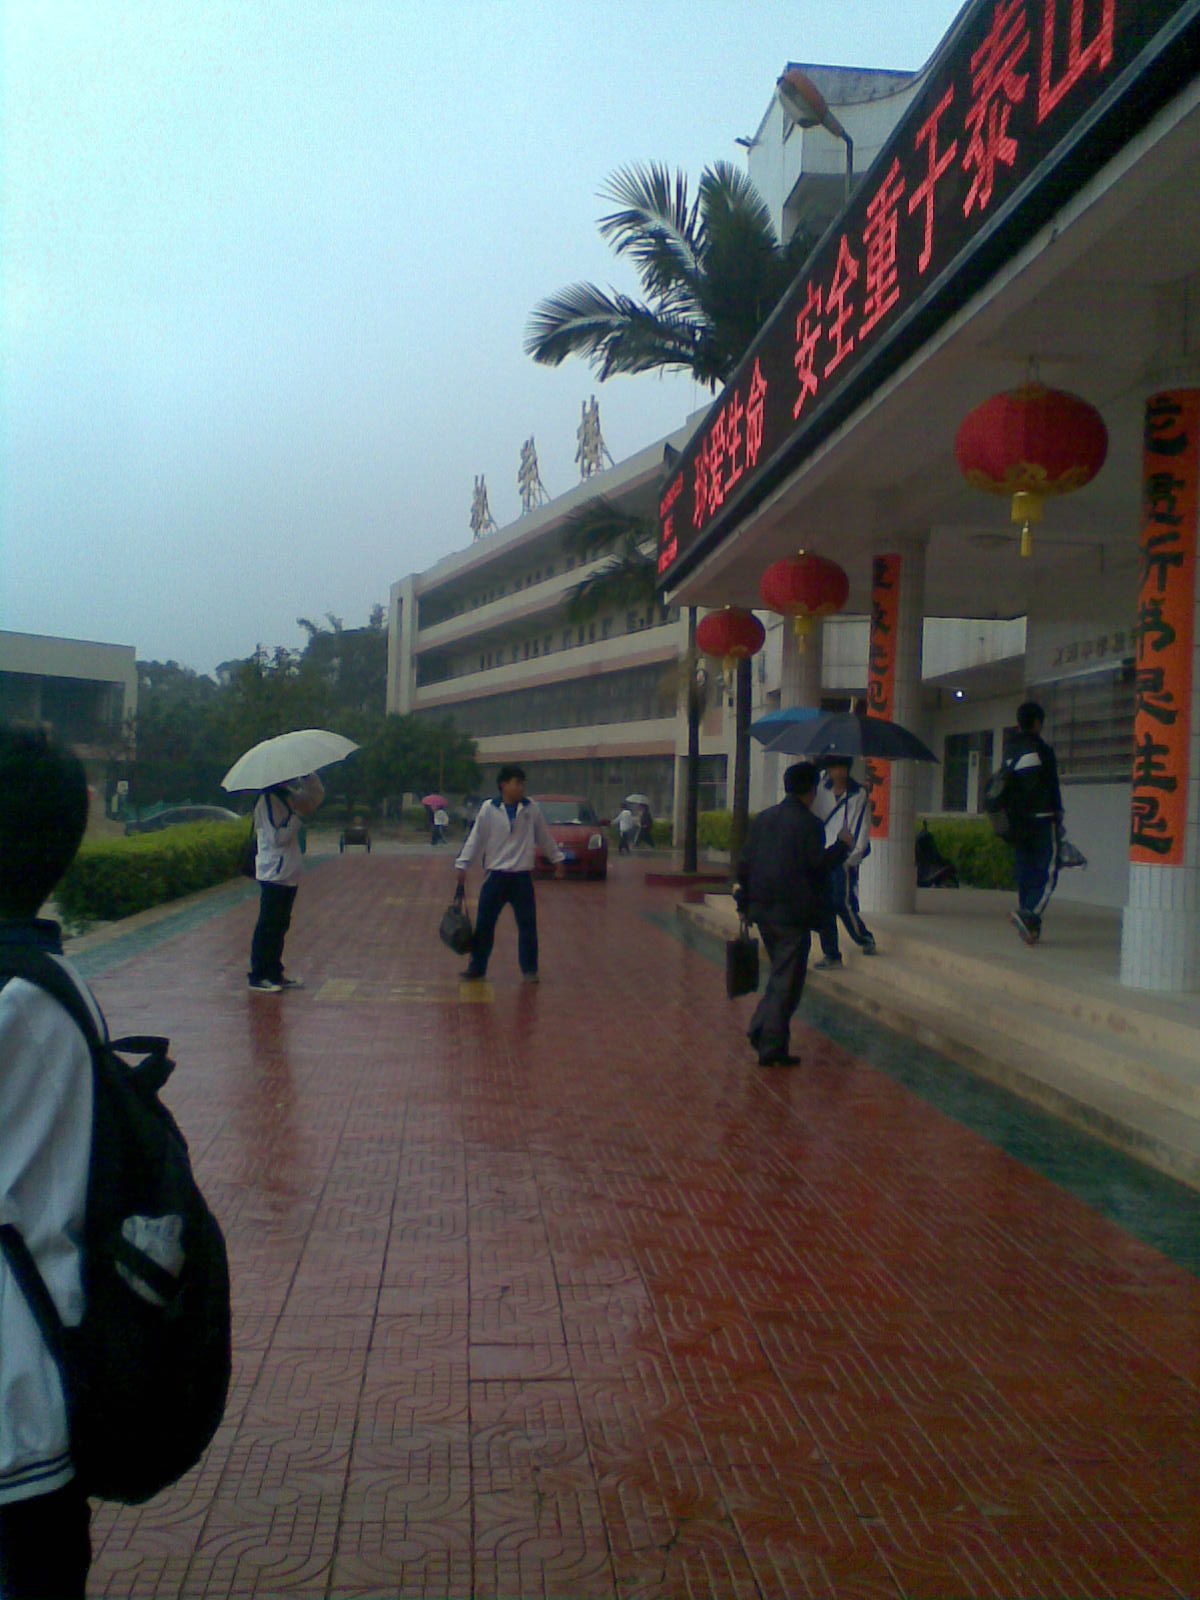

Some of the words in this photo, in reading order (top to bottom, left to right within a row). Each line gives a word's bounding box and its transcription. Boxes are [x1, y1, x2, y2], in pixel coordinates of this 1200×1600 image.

[794, 0, 1115, 419] 安全重于泰山
